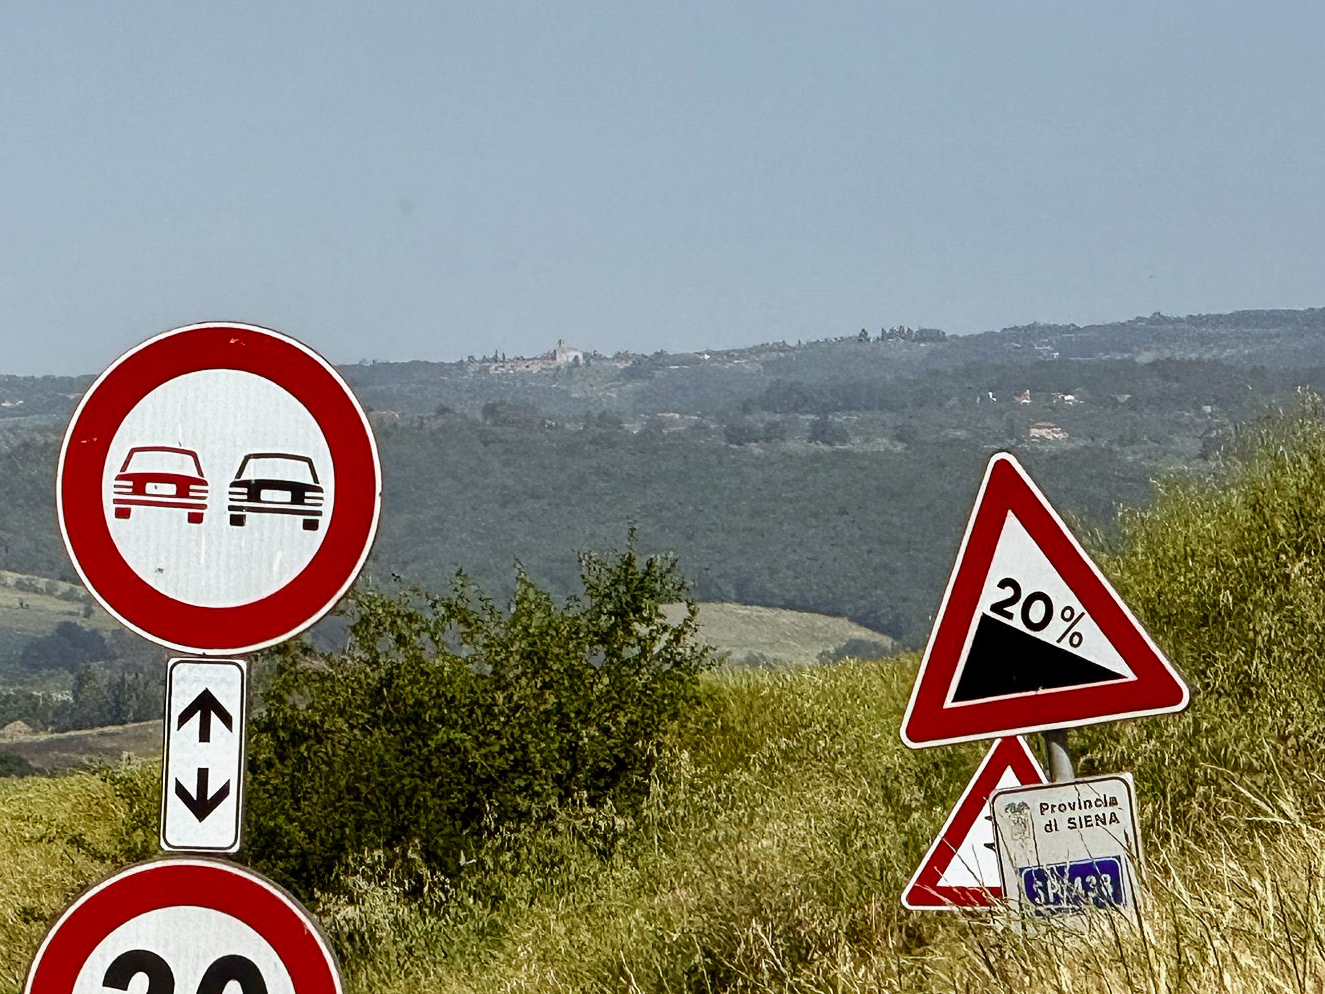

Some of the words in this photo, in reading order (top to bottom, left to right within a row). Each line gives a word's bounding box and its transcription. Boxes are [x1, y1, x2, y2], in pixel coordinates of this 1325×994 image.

[990, 577, 1085, 648] 20%
[1039, 794, 1119, 816] Provincia
[1044, 817, 1059, 833] di
[1067, 812, 1121, 830] SIENA
